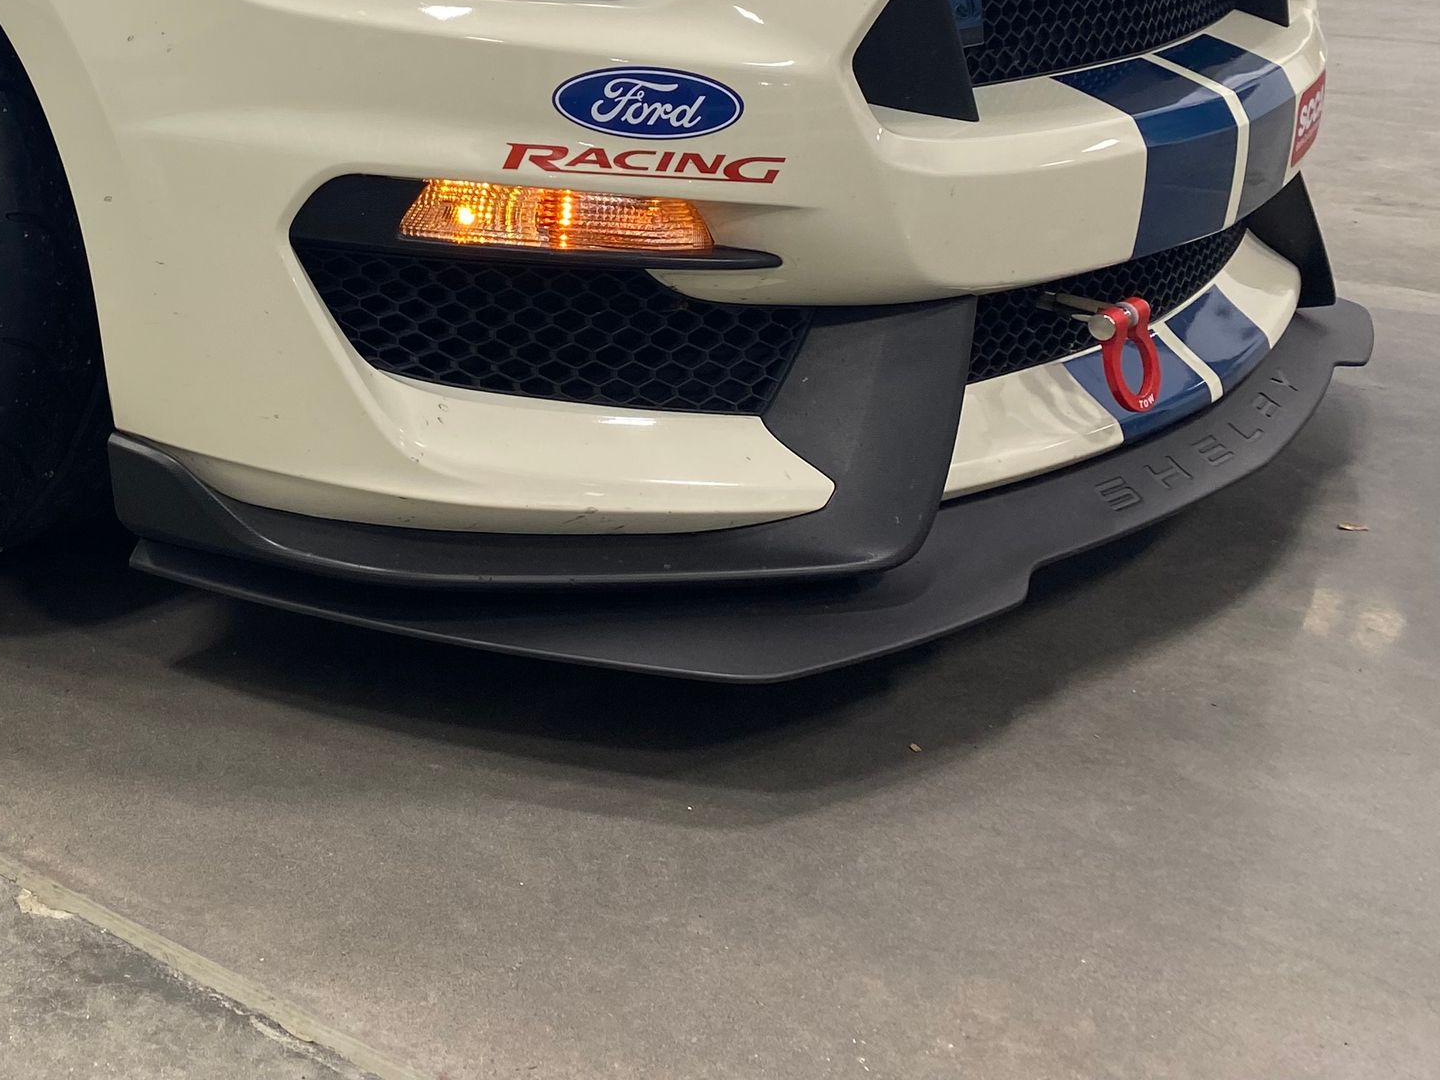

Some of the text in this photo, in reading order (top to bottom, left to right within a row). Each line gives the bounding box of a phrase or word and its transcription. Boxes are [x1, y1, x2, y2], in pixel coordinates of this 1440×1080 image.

[590, 77, 707, 129] Ford
[502, 142, 787, 184] RACING
[1138, 393, 1156, 409] TOW
